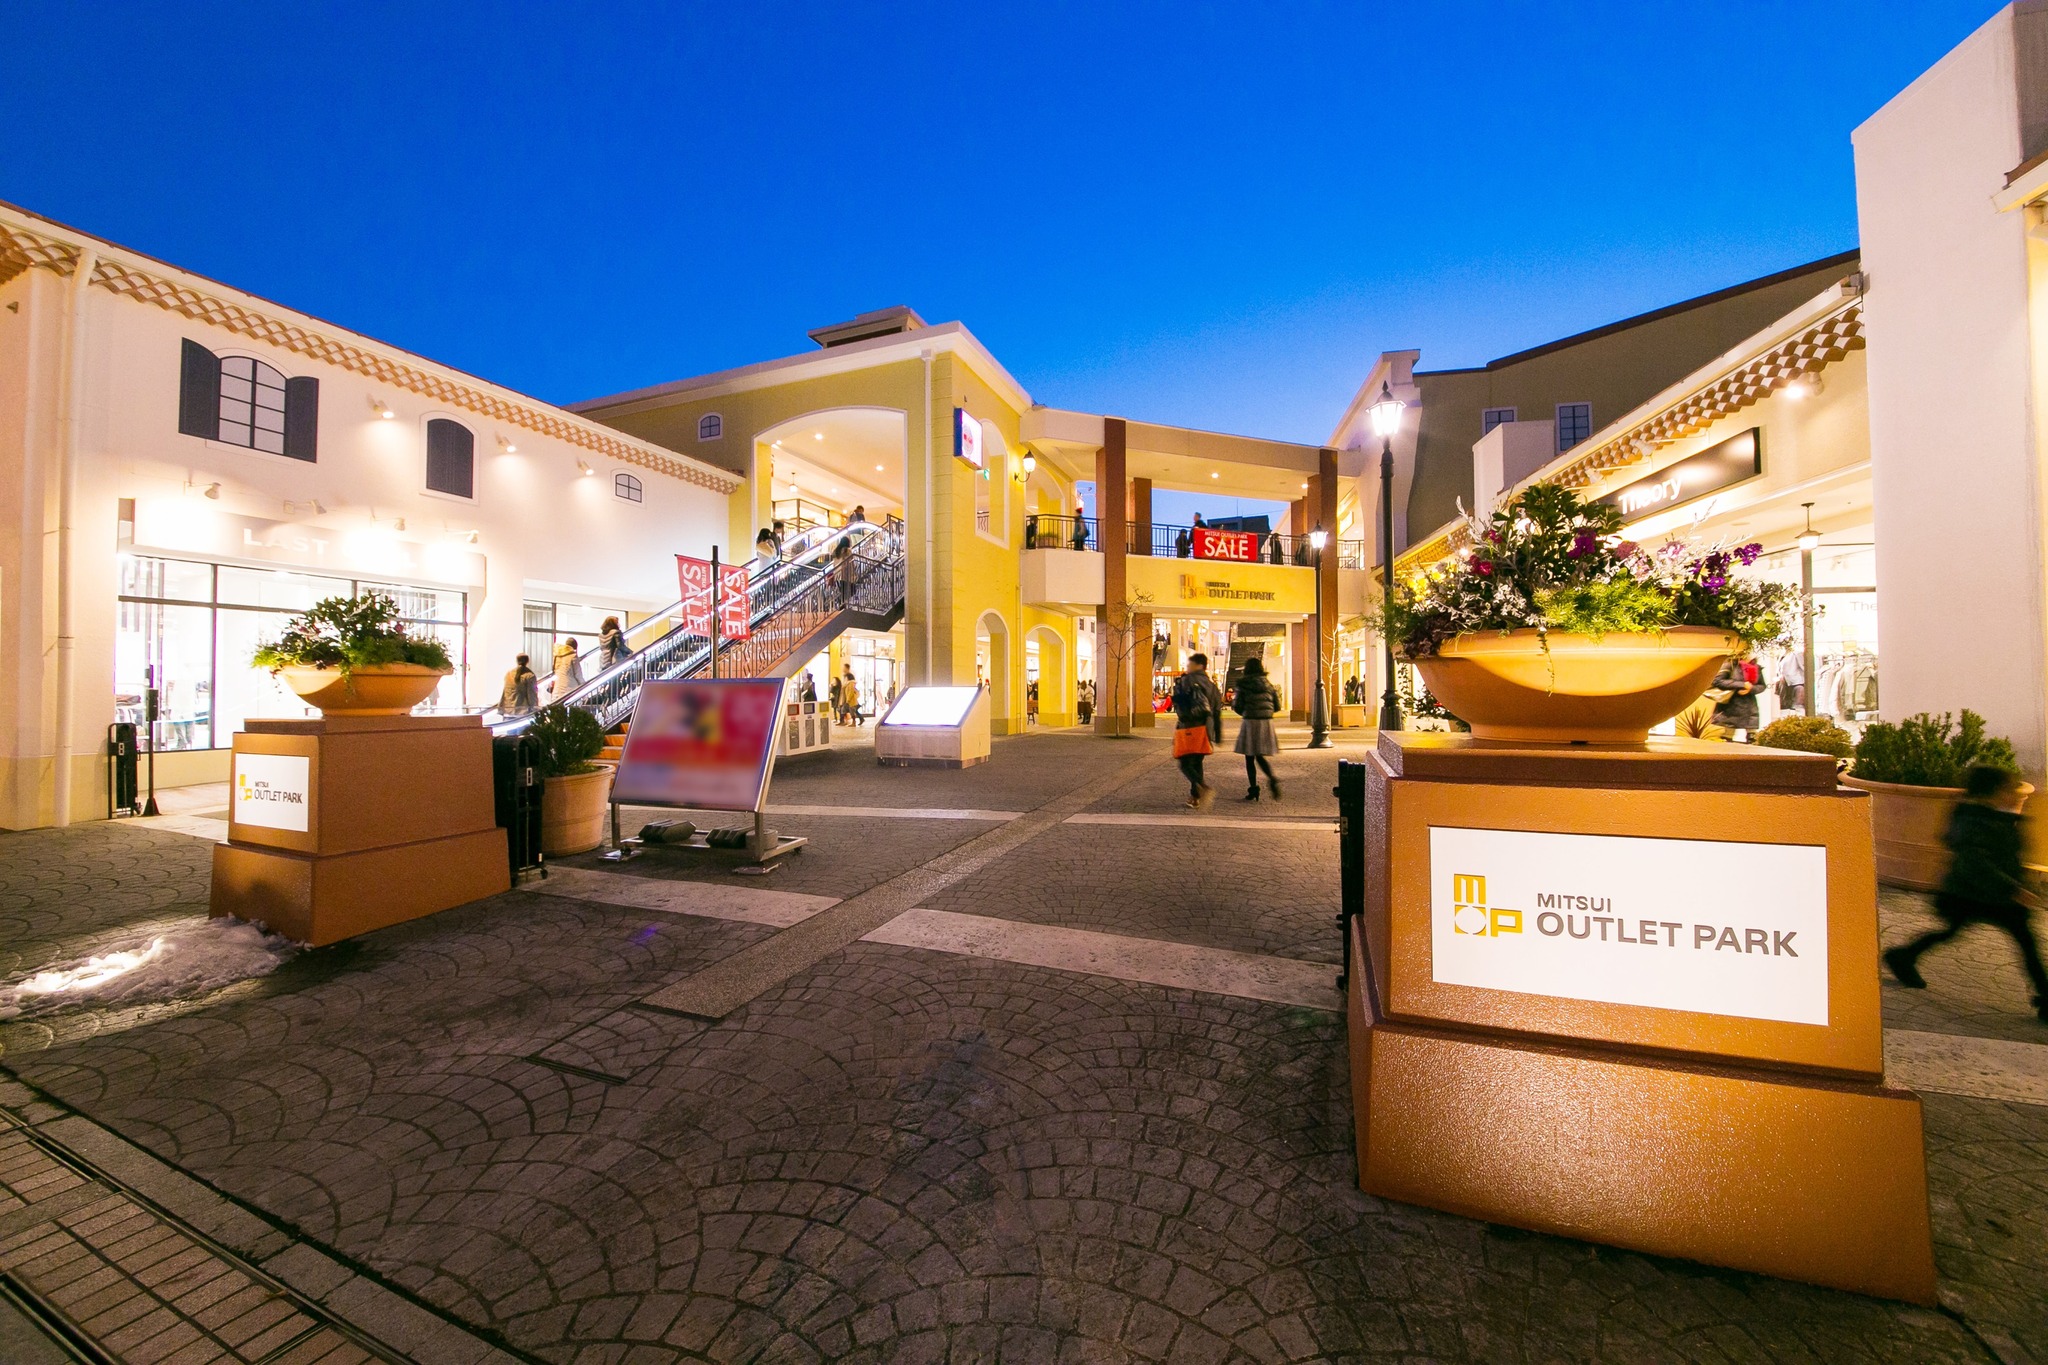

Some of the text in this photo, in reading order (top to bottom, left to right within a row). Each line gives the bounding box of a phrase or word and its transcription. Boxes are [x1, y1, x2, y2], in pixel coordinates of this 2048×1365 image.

[1618, 478, 1681, 514] Theory
[243, 528, 330, 555] LAST
[1204, 537, 1248, 559] SALE
[682, 563, 704, 632] SALE
[724, 571, 742, 636] SALE
[1208, 588, 1275, 601] OUTLET PARK
[254, 789, 303, 804] OUTLET PARK
[1537, 893, 1611, 913] MITSUI
[1536, 912, 1799, 958] OUTLET PARK
